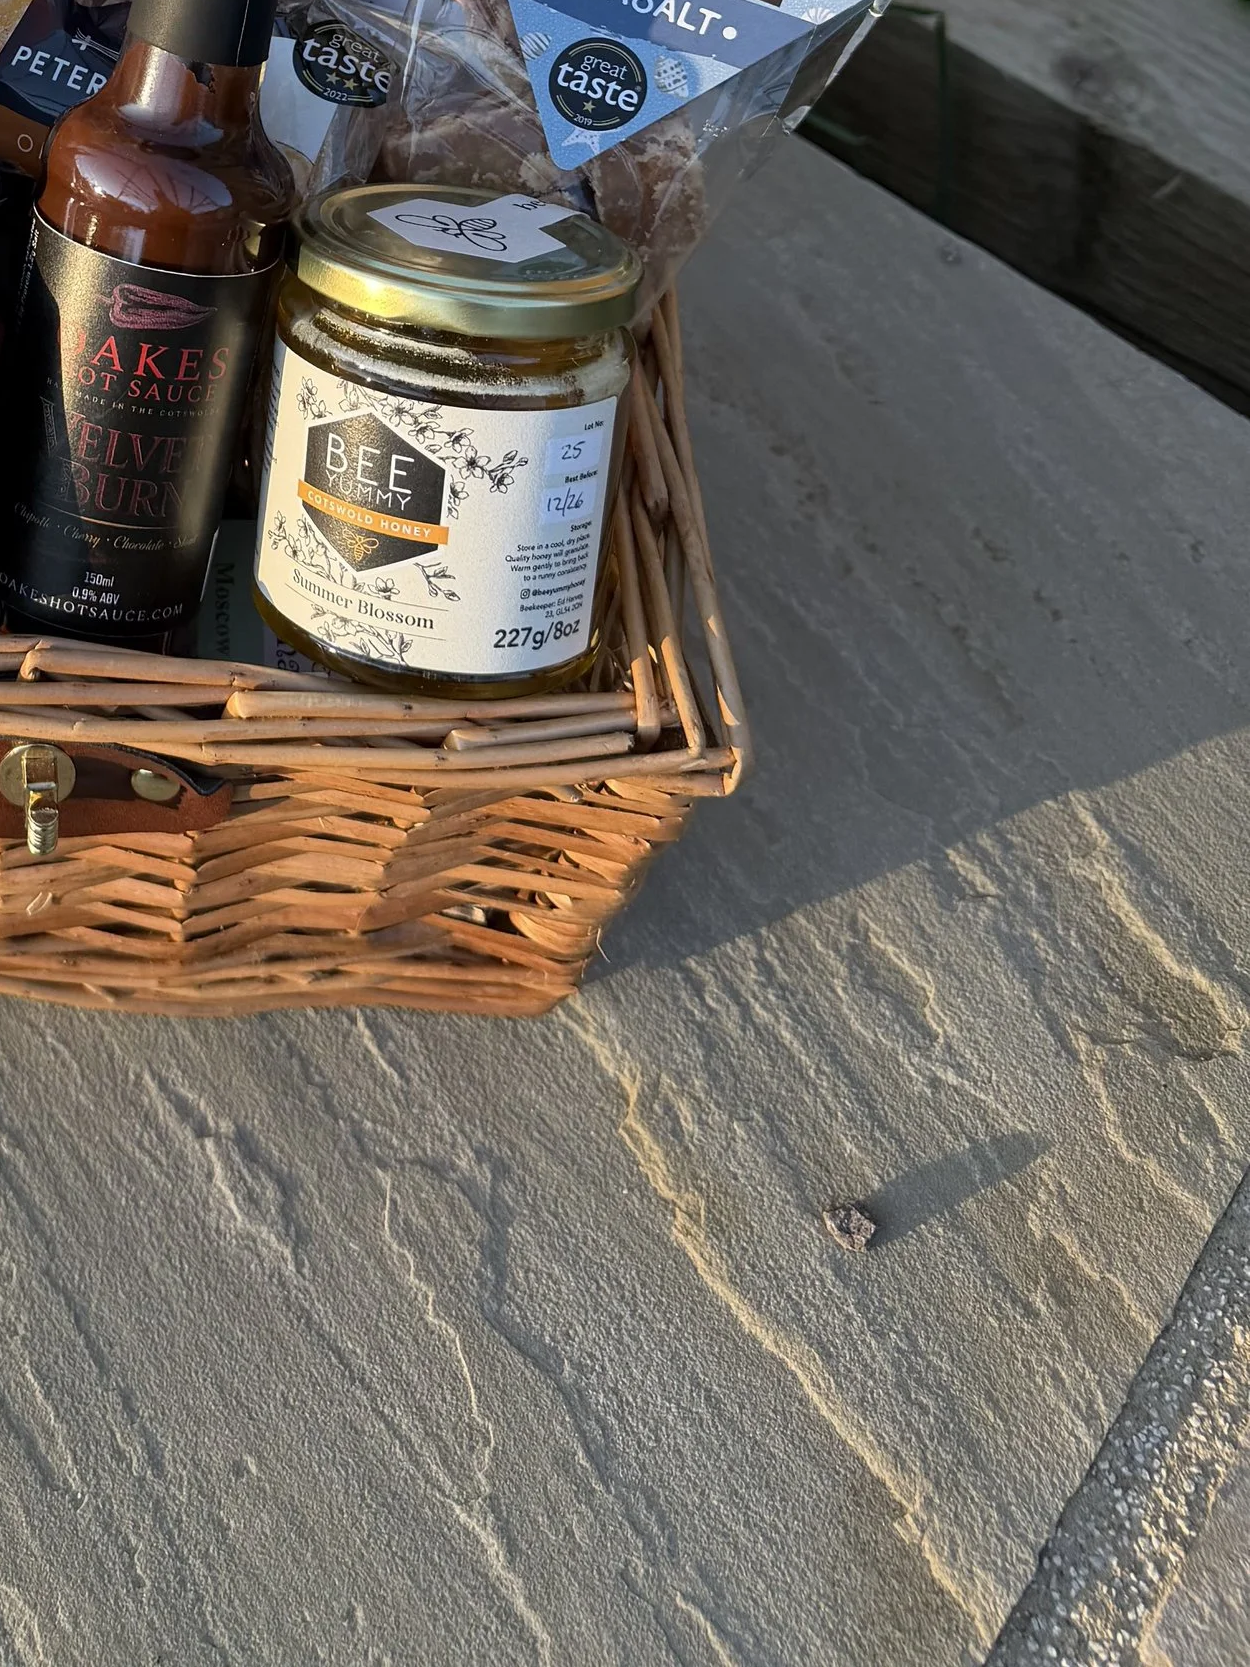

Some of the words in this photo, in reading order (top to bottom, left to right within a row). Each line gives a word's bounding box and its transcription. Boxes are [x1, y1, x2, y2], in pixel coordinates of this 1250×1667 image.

[329, 33, 380, 62] great
[302, 38, 392, 94] taste
[581, 55, 627, 80] great
[323, 87, 348, 102] 2022
[557, 63, 638, 112] taste
[573, 114, 593, 126] 2019
[77, 366, 117, 392] OT
[128, 380, 215, 403] SAUCE
[112, 400, 124, 410] IN
[131, 405, 153, 415] THE
[326, 432, 415, 495] BEE
[561, 441, 586, 460] 25
[58, 456, 189, 518] BURN
[326, 469, 411, 511] YUMMY
[547, 487, 584, 517] 12/26
[308, 490, 373, 525] COTSWOLD
[380, 519, 431, 538] HONEY
[64, 524, 100, 548] Cherry
[114, 535, 164, 551] Chocolate
[505, 555, 530, 563] Quality
[84, 571, 114, 588] 150ml
[0, 571, 183, 622] OAKESHOTSAUCE.COM
[72, 586, 97, 603] 0.9%
[100, 593, 120, 605] ABV
[214, 562, 236, 655] Moscow
[292, 568, 353, 609] Summer
[358, 599, 434, 630] Blossom
[493, 619, 581, 650] 227g/8oz
